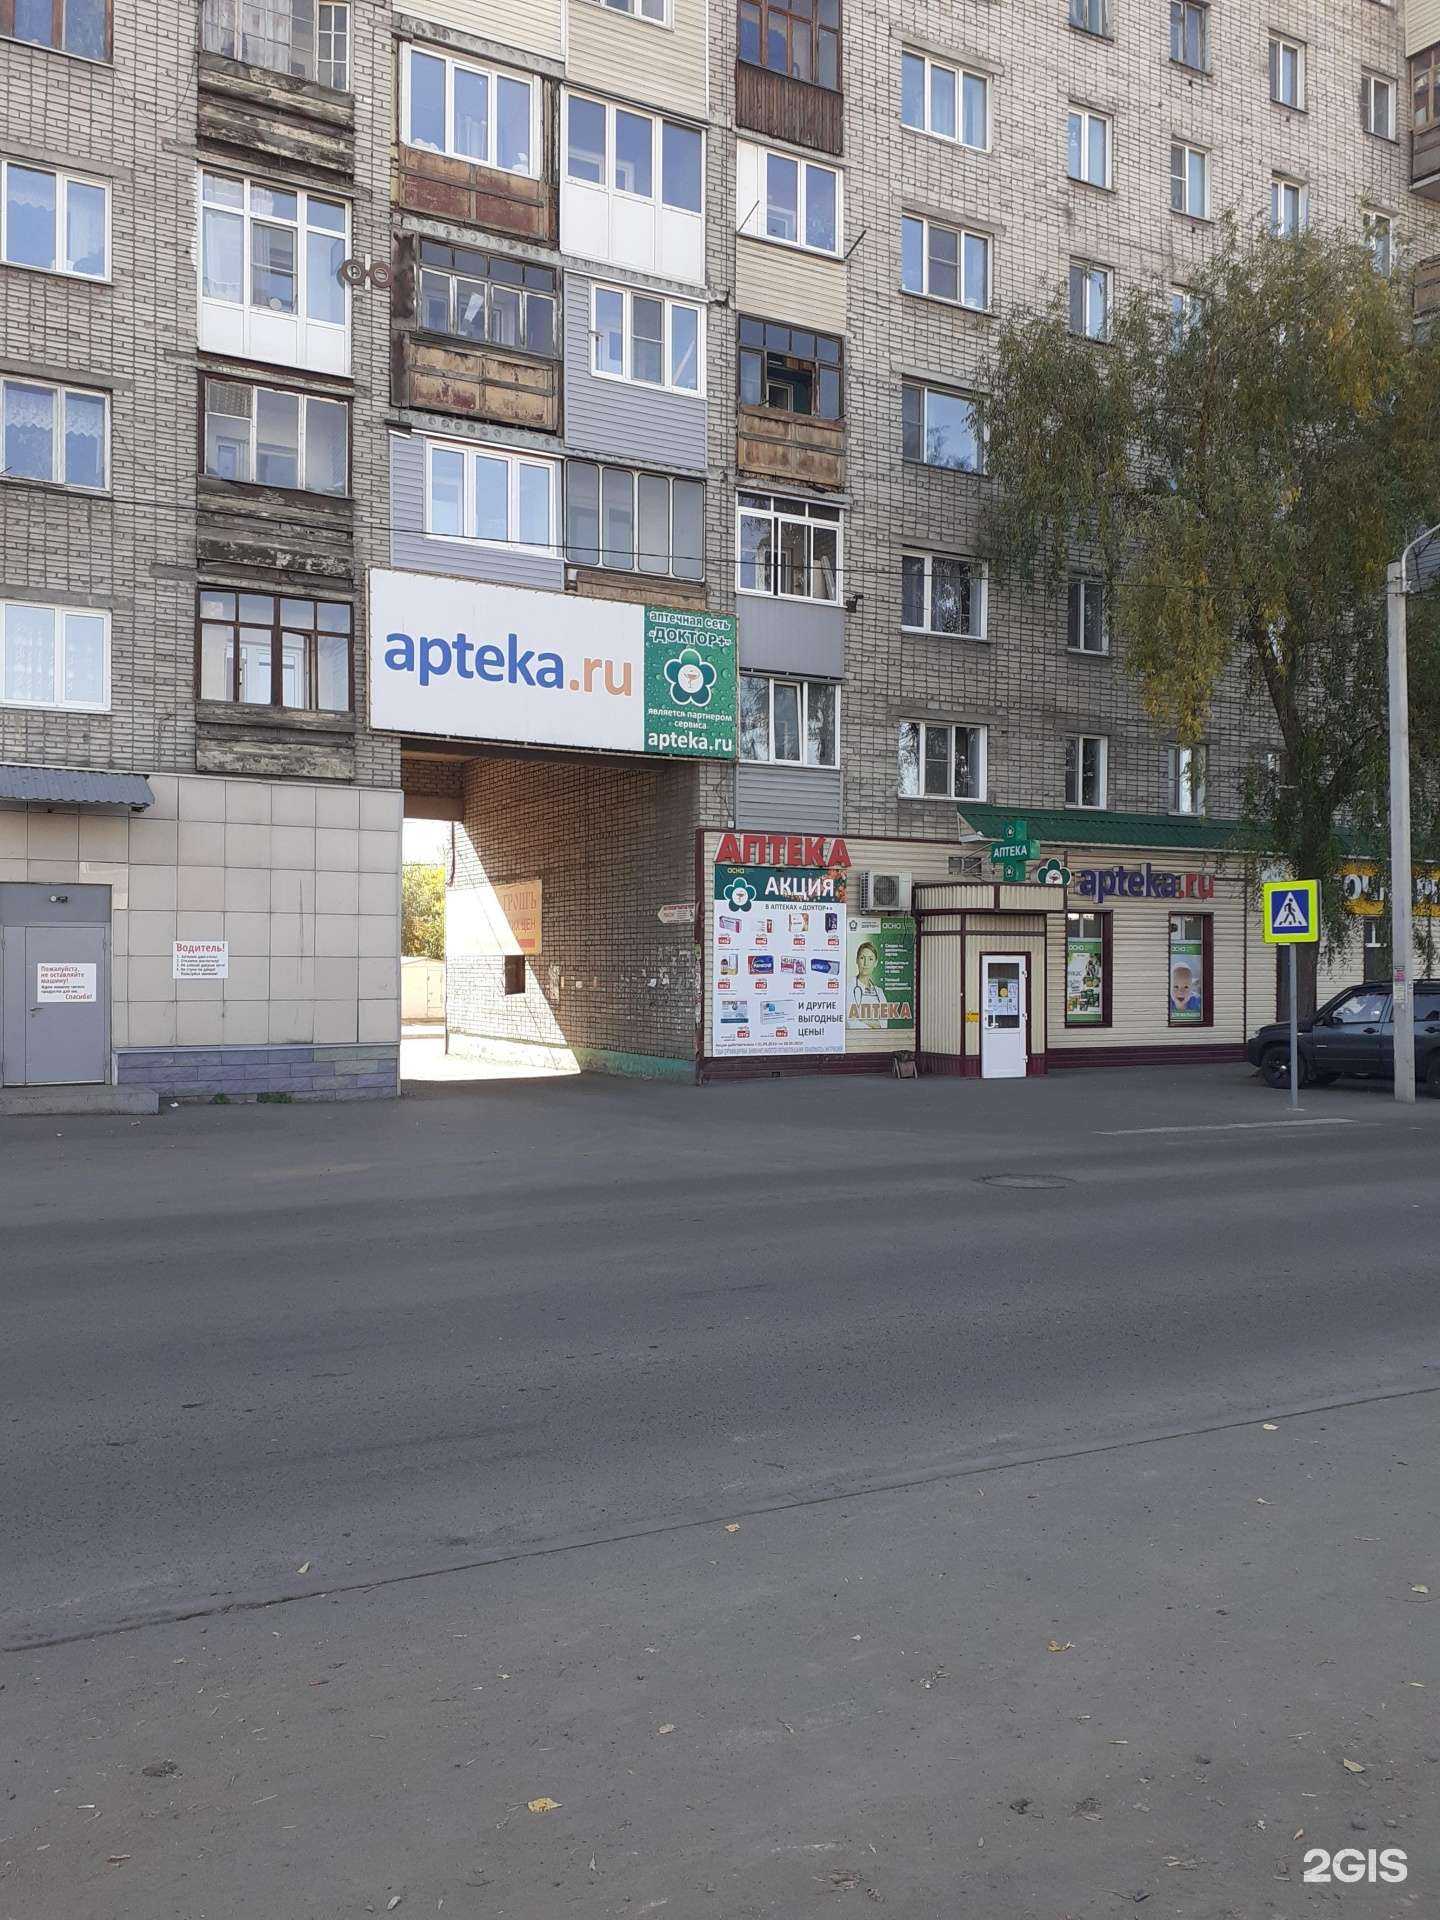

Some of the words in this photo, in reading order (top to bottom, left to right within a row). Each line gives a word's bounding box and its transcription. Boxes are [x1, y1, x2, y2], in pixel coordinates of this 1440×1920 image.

[649, 611, 703, 627] аптечная
[704, 618, 731, 631] сеть
[384, 632, 632, 697] apteka.ru
[648, 708, 686, 718] является
[687, 711, 733, 723] партнером
[674, 720, 707, 730] сервиса
[648, 731, 733, 752] apteka.ru
[714, 833, 852, 868] АПТЕКА
[993, 845, 1028, 858] АПТЕКА
[764, 876, 834, 900] АКЦИЯ
[1076, 862, 1217, 904] apteka.ru
[771, 903, 798, 911] АПТЕКАХ
[176, 943, 225, 954] Водитель!
[798, 1001, 804, 1010] И
[806, 1001, 837, 1012] ДРУГИЕ
[848, 1002, 912, 1019] АПТЕКА
[798, 1014, 844, 1025] ВЫГОДНЫЕ
[798, 1028, 825, 1037] ЦЕНЫ!
